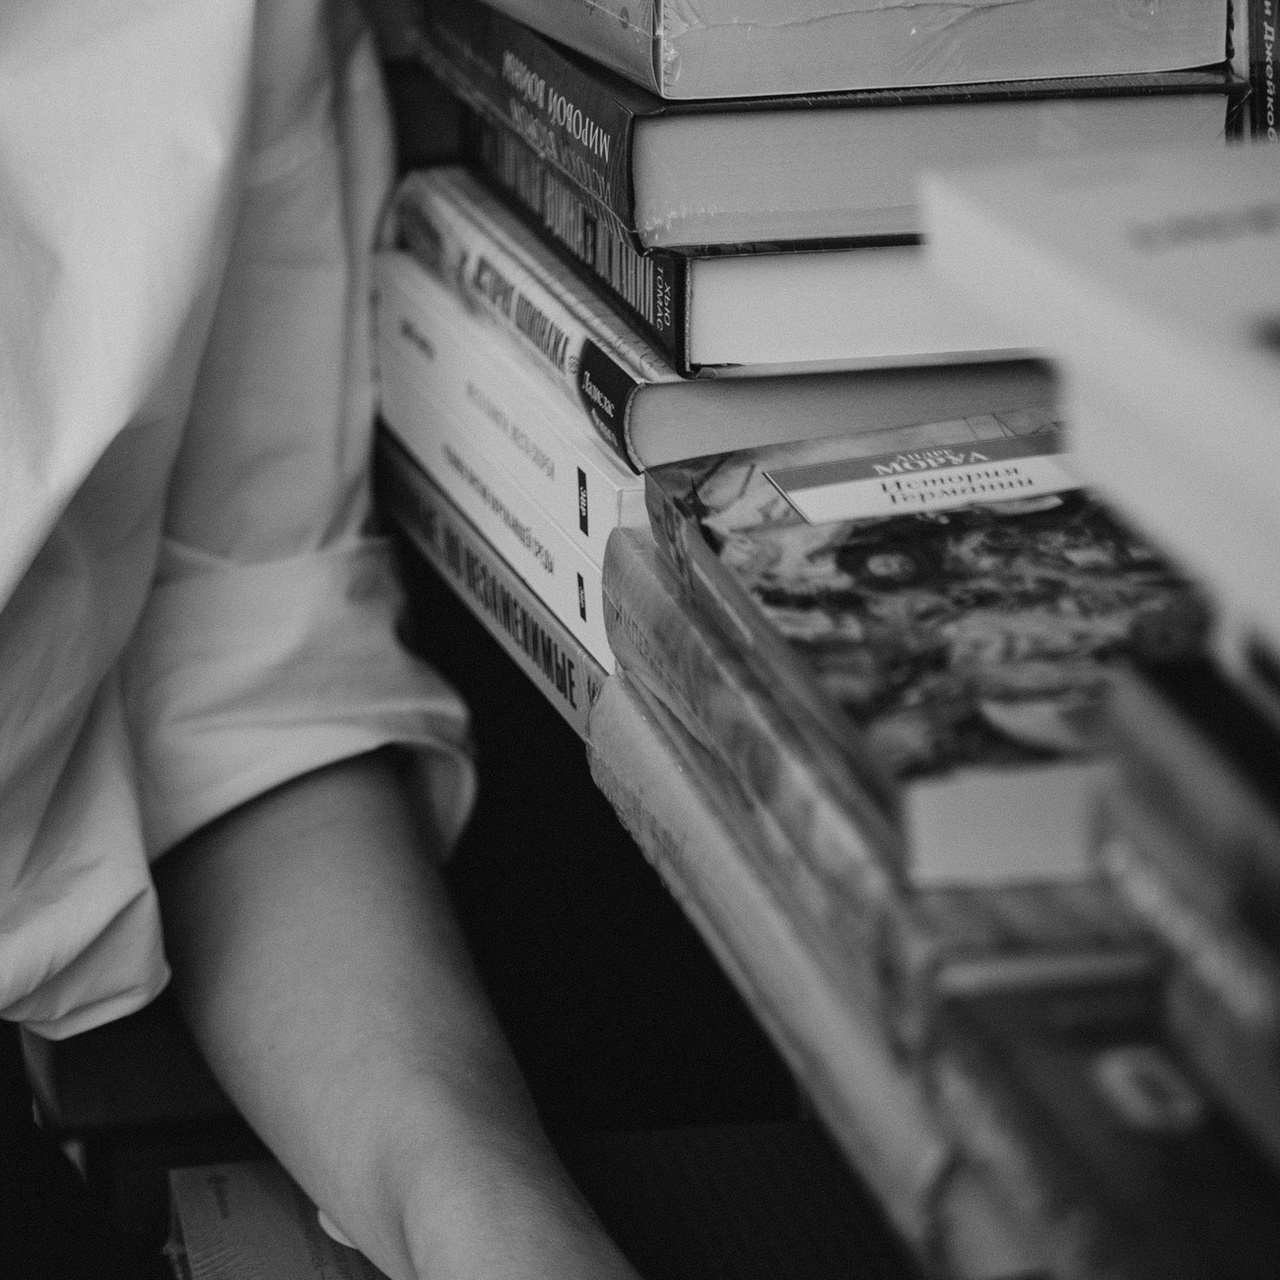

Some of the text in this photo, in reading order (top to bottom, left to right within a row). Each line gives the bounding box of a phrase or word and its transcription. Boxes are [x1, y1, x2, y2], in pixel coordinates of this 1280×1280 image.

[547, 86, 612, 163] МИРОВОЙ
[656, 266, 664, 332] ТОМАС
[663, 281, 672, 327] ХЬЮ
[880, 465, 1020, 493] История
